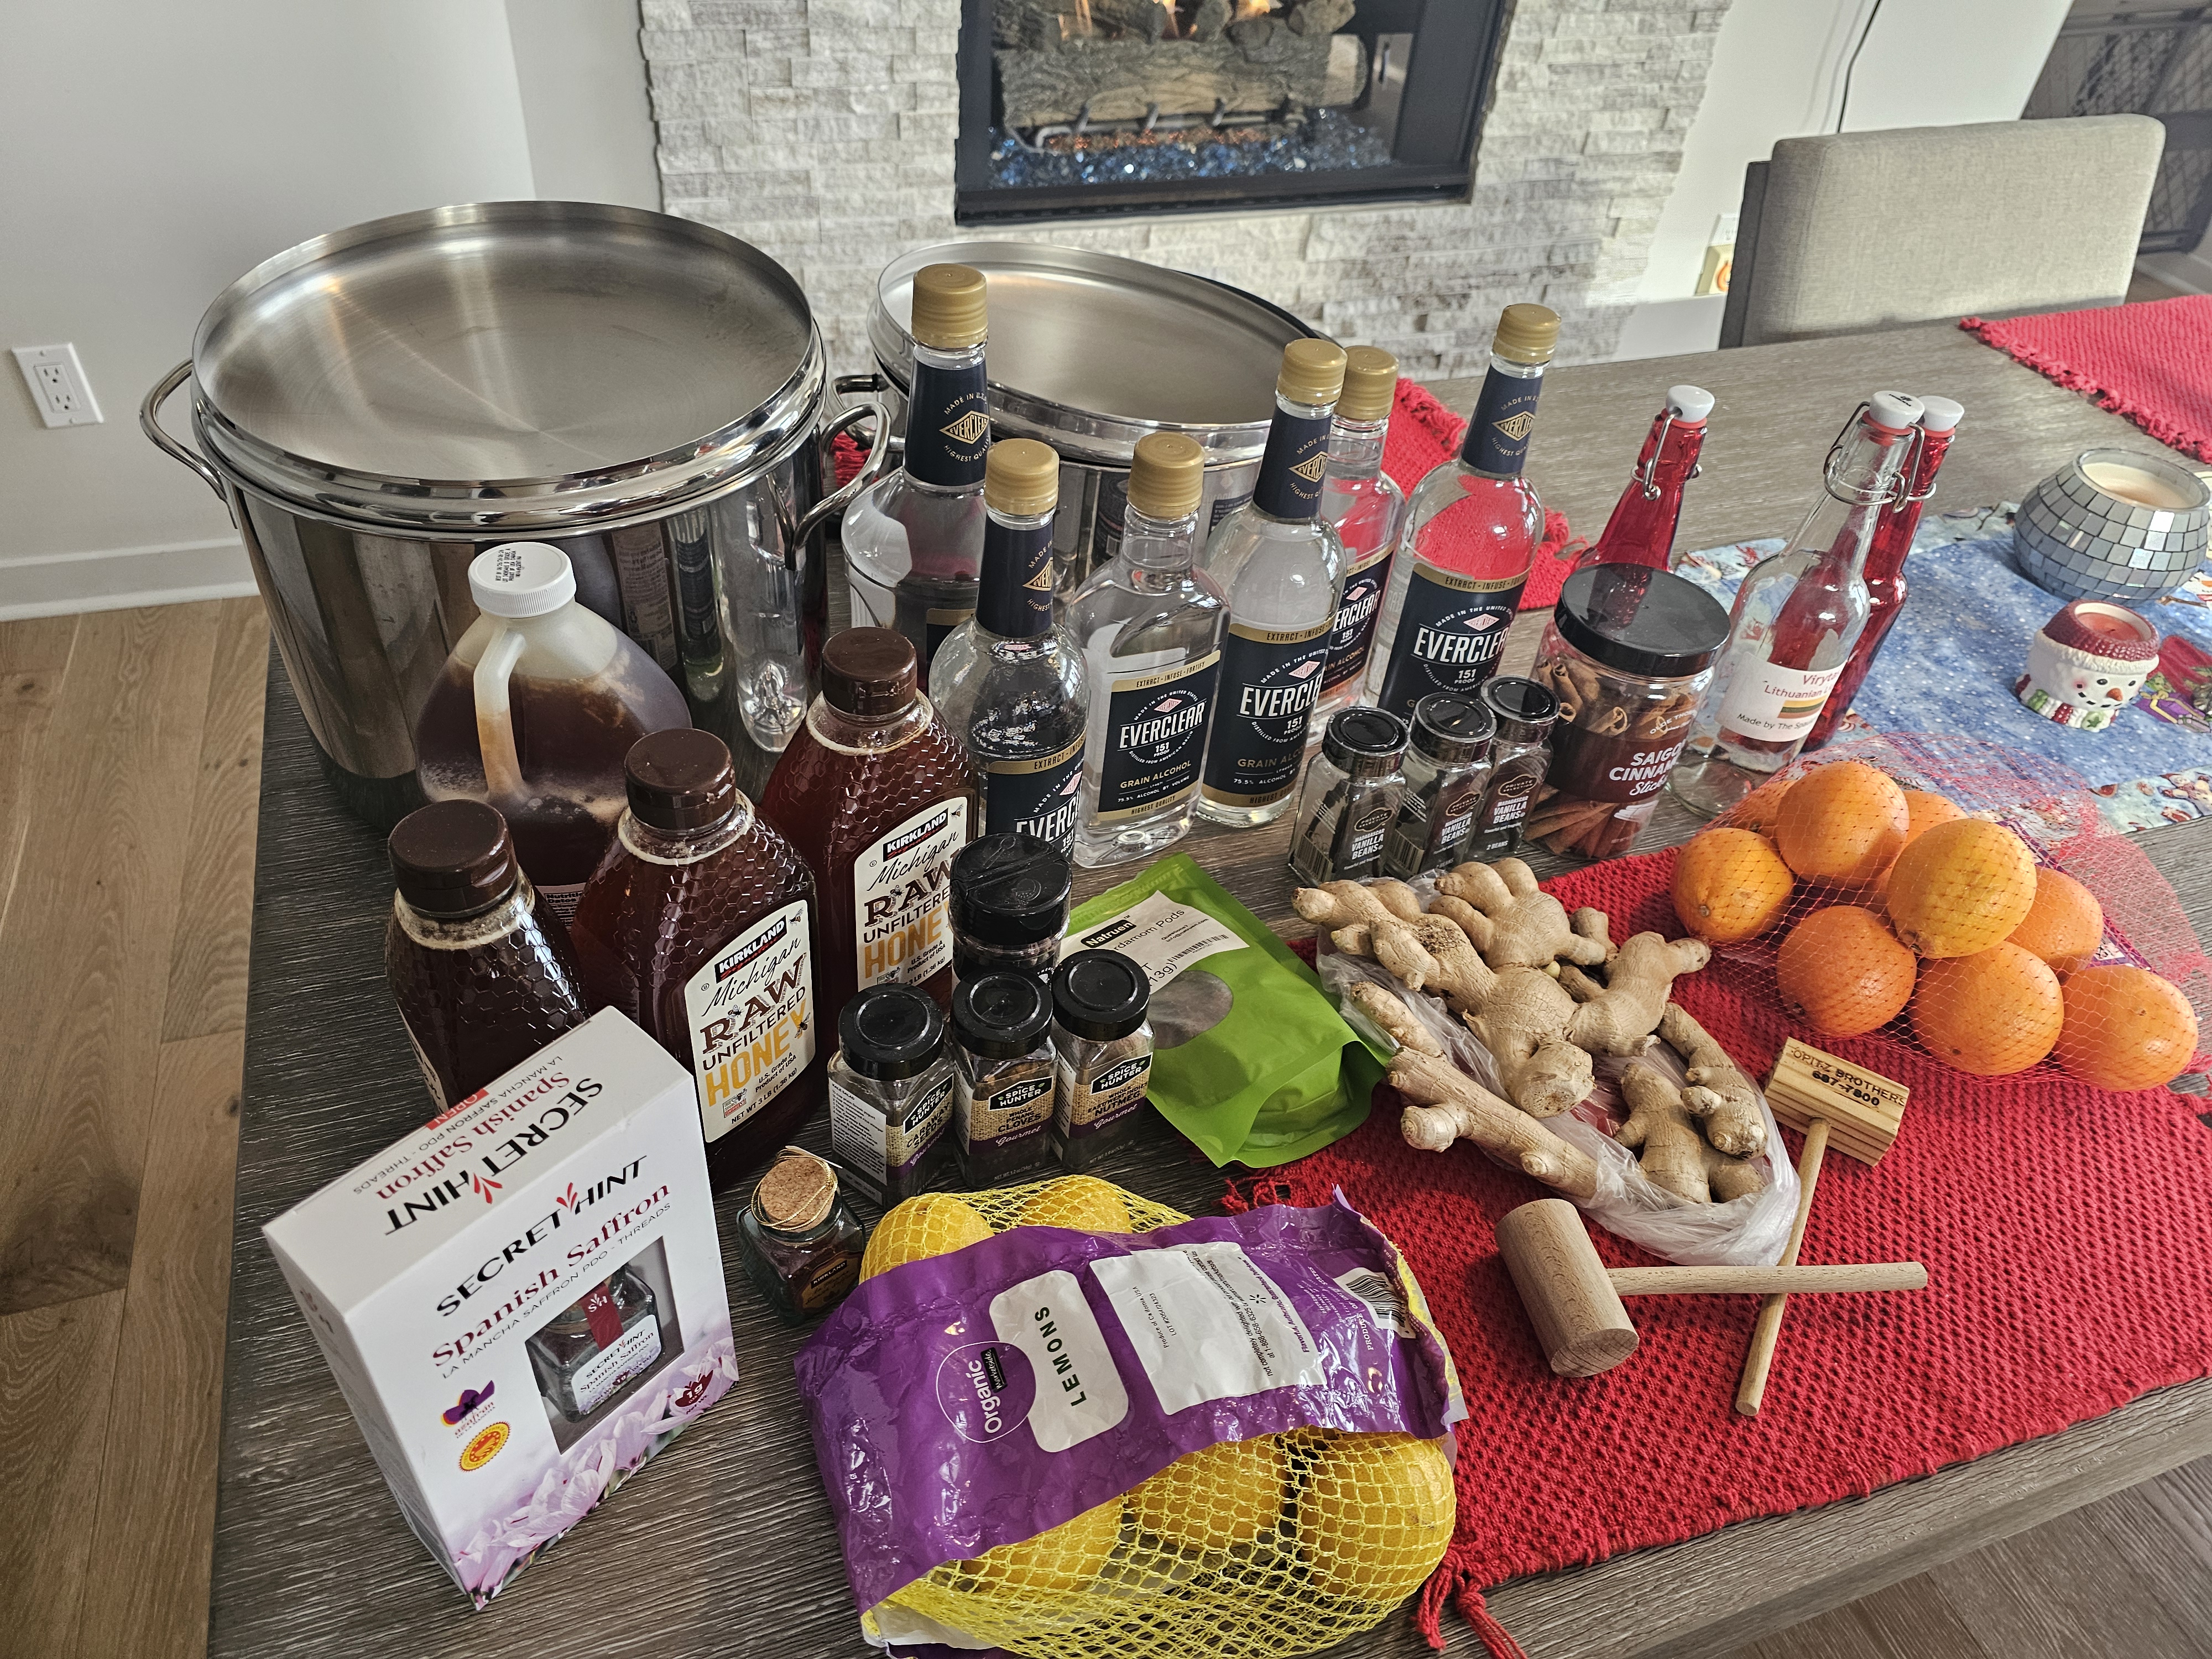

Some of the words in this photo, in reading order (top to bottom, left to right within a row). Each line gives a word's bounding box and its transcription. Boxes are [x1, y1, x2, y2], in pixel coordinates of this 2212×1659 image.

[944, 396, 964, 415] MADE
[1501, 397, 1522, 411] MADE
[1296, 438, 1317, 455] MADE
[1290, 482, 1313, 499] HIGHEST
[1029, 546, 1046, 568] MADE
[1445, 577, 1477, 589] EXTRACT
[1483, 582, 1509, 590] INFUSE
[1333, 589, 1381, 632] ERCLEAR
[1436, 614, 1455, 627] MADE
[1266, 632, 1299, 642] EXTRACT
[1304, 625, 1326, 639] INFUSE
[1342, 629, 1353, 639] 151
[1413, 627, 1509, 664] EVERCLEA
[1136, 677, 1160, 687] EXTRACT
[1164, 671, 1182, 682] INFUSE
[1260, 668, 1280, 684] MADE
[1293, 655, 1306, 664] THE
[1423, 664, 1442, 686] DISTILLED
[1458, 669, 1477, 679] 151
[1240, 674, 1322, 717] EVERCLE
[1764, 685, 1823, 698] Lithuanian
[1134, 706, 1148, 721] MADE
[1287, 716, 1303, 729] 151
[1736, 713, 1760, 727] Made
[1764, 720, 1775, 731] by
[1120, 702, 1206, 749] EVERCLEAR
[1251, 721, 1272, 740] DISTILLED
[1129, 750, 1145, 763] DISTILLED
[1154, 749, 1170, 758] PROOF
[1155, 742, 1170, 752] 151
[1034, 752, 1064, 770] EXTRACT
[1237, 758, 1277, 769] GRAIN
[1609, 757, 1679, 781] CINNAM
[1120, 775, 1151, 789] GRAIN
[1153, 760, 1192, 780] ALCOHOL
[1258, 774, 1287, 785] ALCOHOL
[1505, 780, 1533, 789] PRIVATE
[1136, 789, 1160, 799] ALCOHOL
[1172, 775, 1190, 786] VOLUME
[1131, 804, 1154, 815] HIGHEST
[1452, 796, 1477, 809] PRIVATE
[1494, 801, 1527, 816] VANILLA
[1361, 812, 1388, 824] PRIVATE
[1442, 818, 1471, 836] VANILLA
[1493, 811, 1520, 824] BEANS
[887, 812, 947, 853] KIRKLAND
[1062, 828, 1074, 847] 151
[1352, 834, 1384, 851] VANILLA
[1441, 829, 1465, 844] BEANS
[1352, 844, 1379, 860] BEANS
[1491, 841, 1509, 849] BEANS
[867, 831, 959, 891] Michigan
[864, 887, 950, 943] UNFILTERE
[864, 901, 948, 979] HONE
[1086, 920, 1133, 946] Natruen
[1113, 926, 1157, 951] rdamom
[1159, 909, 1185, 928] Pods
[1161, 925, 1188, 941] Questions?
[719, 920, 785, 973] KIRKLAND
[923, 944, 938, 957] Grade
[907, 958, 928, 974] Product
[936, 944, 946, 954] USA
[701, 938, 801, 1017] Michigan
[914, 973, 922, 983] LB
[700, 953, 807, 1054] RAW
[703, 987, 805, 1071] UNFILTERED
[547, 1056, 563, 1066] LA
[705, 998, 806, 1107] HONEY
[755, 1072, 778, 1093] Product
[785, 1055, 796, 1067] USA
[759, 1073, 770, 1083] U.S.
[771, 1058, 787, 1073] Grade
[1101, 1067, 1142, 1089] HUNTER
[1108, 1063, 1138, 1080] SPICE
[498, 1066, 547, 1098] MANCHA
[1005, 1084, 1035, 1099] SPICE
[1108, 1085, 1131, 1099] WHOLE
[1835, 1068, 1906, 1107] BROTHERS
[472, 1072, 570, 1135] Spanish
[732, 1110, 745, 1124] NET
[747, 1102, 757, 1113] WT
[764, 1090, 772, 1100] LB
[774, 1078, 787, 1093] (1.36
[788, 1068, 797, 1078] kg)
[917, 1088, 941, 1113] SPICE
[1000, 1088, 1041, 1107] HUNTER
[1094, 1092, 1140, 1117] NUTMEG
[446, 1097, 498, 1133] SAFFRON
[912, 1091, 945, 1126] HUNTER
[1006, 1111, 1035, 1124] PENANG
[1009, 1107, 1032, 1118] WHOLE
[1094, 1104, 1138, 1130] Gourmet
[482, 1078, 603, 1176] SECRET
[907, 1102, 950, 1148] CARAWAY
[914, 1117, 943, 1149] SEEDS
[998, 1113, 1042, 1133] CLOVES
[419, 1132, 445, 1151] PDO
[996, 1125, 1041, 1147] Gourmet
[910, 1128, 945, 1167] Gourmet
[353, 1156, 411, 1194] THREADS
[376, 1136, 473, 1199] Saffron
[385, 1170, 469, 1235] HINT
[437, 1209, 561, 1317] SECRET
[575, 1156, 647, 1214] HINT
[432, 1267, 559, 1366] Spanish
[567, 1185, 670, 1267] Saffron
[813, 1262, 846, 1284] KIRKLAND
[442, 1366, 458, 1379] LA
[463, 1319, 519, 1365] MANCHA
[524, 1272, 578, 1317] SAFFRON
[583, 1251, 607, 1272] PDO
[618, 1203, 670, 1245] THREADS
[1350, 1301, 1358, 1310] OF
[1168, 1325, 1177, 1336] LOT
[1241, 1311, 1253, 1336] delighted
[1248, 1307, 1271, 1352] 1-888-658-6325
[1357, 1313, 1374, 1350] PRODUCE
[1155, 1327, 1170, 1348] Produce
[581, 1361, 618, 1392] Spanish
[620, 1332, 654, 1360] Saffron
[586, 1347, 620, 1379] SECRET
[623, 1329, 645, 1348] HINT
[1035, 1307, 1087, 1407] LEMONS
[1249, 1337, 1269, 1366] completely
[1263, 1366, 1273, 1376] not
[966, 1360, 1002, 1433] Organic
